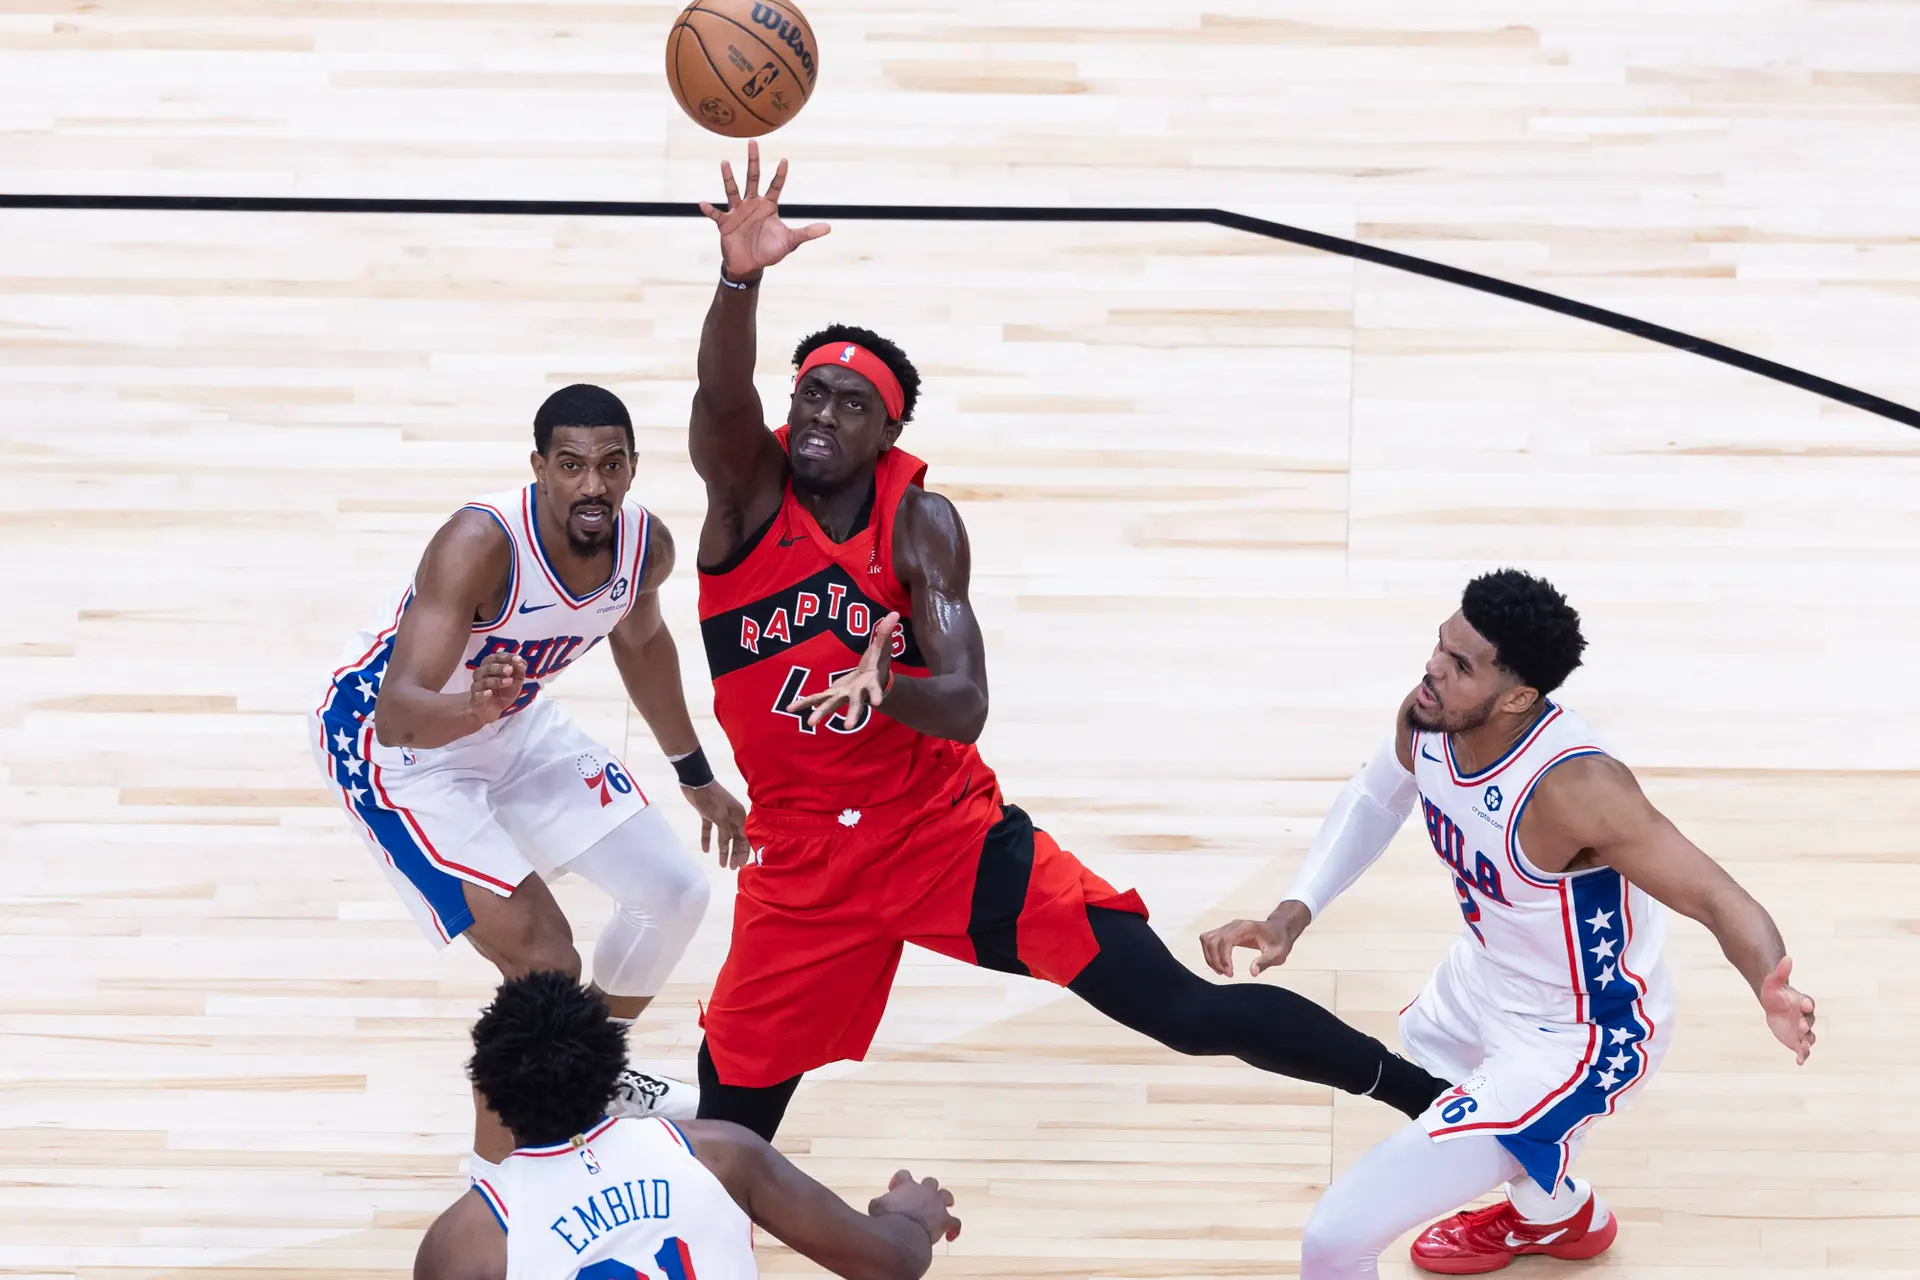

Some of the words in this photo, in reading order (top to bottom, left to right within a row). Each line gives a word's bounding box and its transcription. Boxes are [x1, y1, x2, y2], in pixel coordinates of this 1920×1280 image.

[751, 2, 816, 88] Wilson
[867, 565, 882, 574] ife
[597, 602, 628, 614] crypto.com
[740, 582, 906, 658] RAPTOS
[583, 762, 632, 808] 76
[1471, 805, 1504, 831] crypto.com
[550, 1179, 670, 1255] EMBIID
